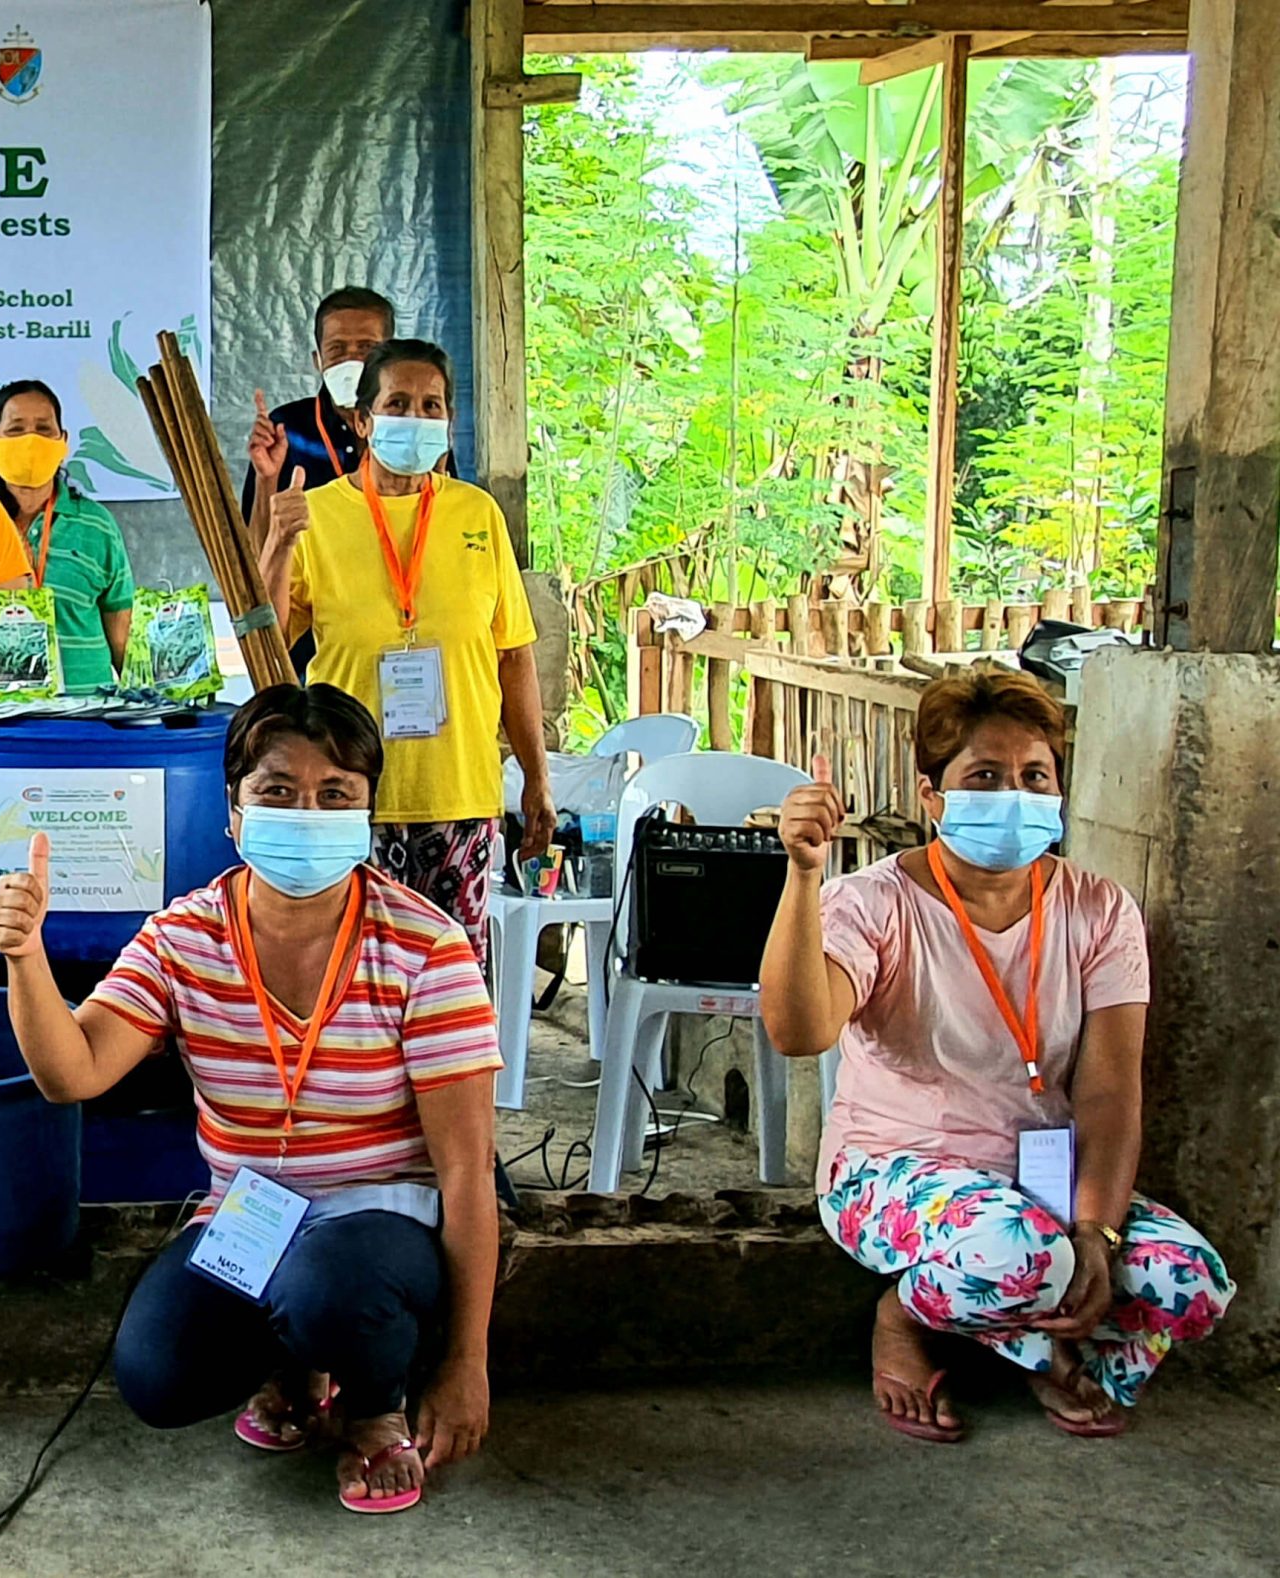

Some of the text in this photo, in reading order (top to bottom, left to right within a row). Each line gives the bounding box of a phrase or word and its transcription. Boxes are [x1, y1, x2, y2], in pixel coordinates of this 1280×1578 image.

[28, 810, 128, 823] WELCOME
[49, 885, 80, 896] OMEO
[199, 1257, 254, 1292] PARTICIPANT
